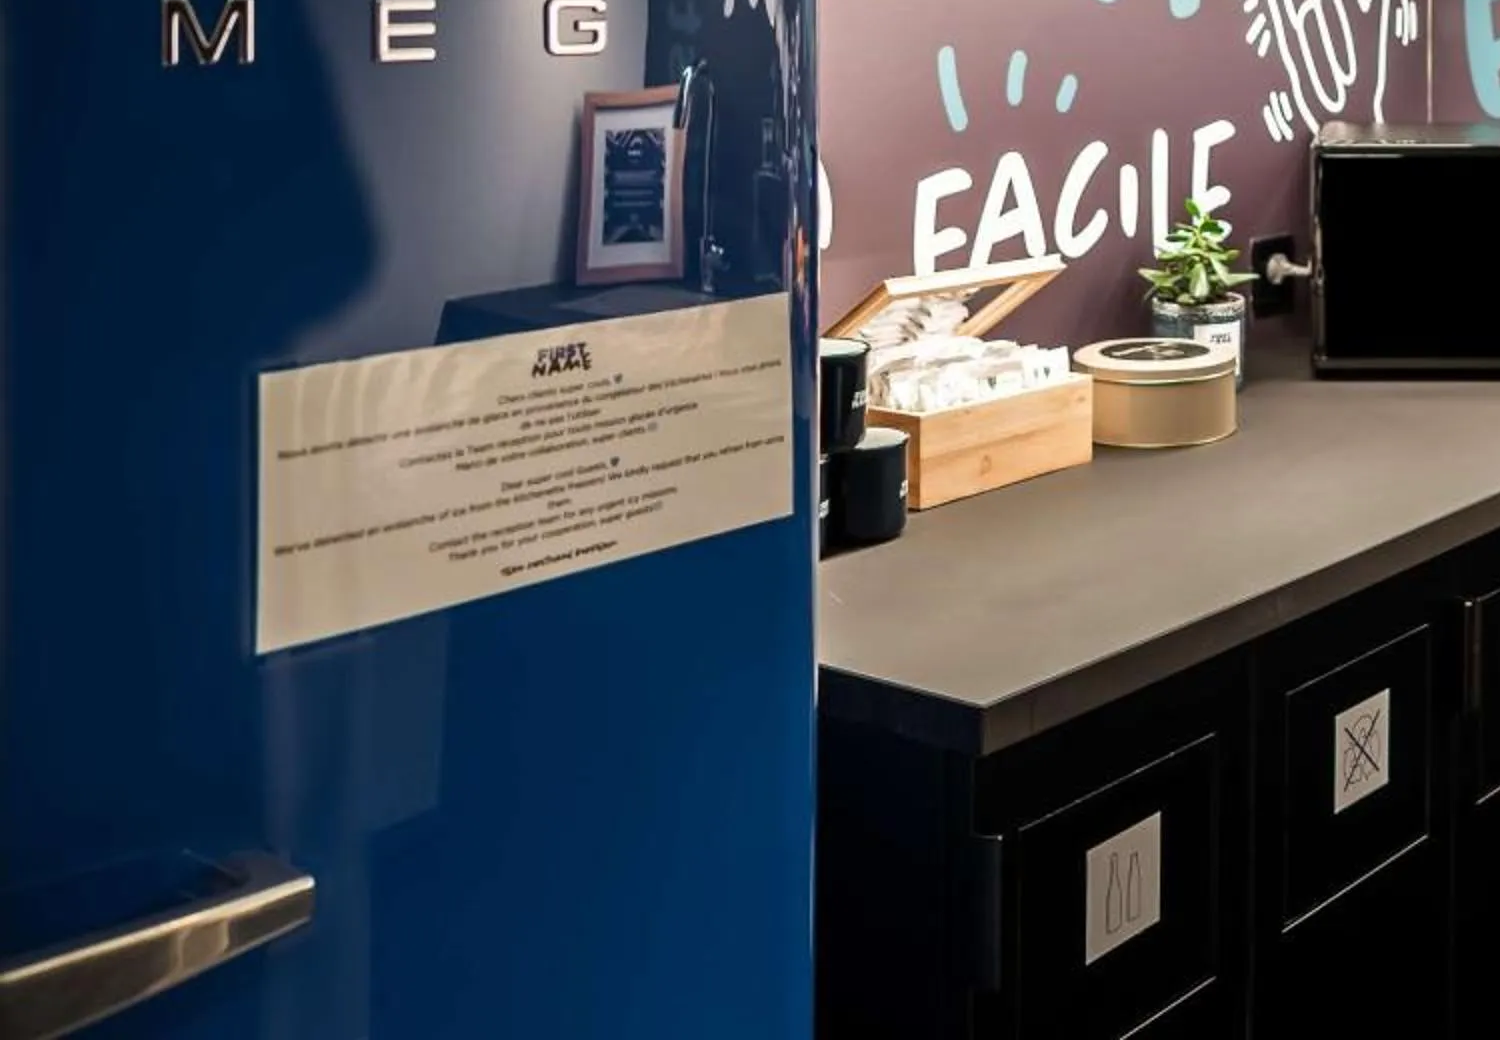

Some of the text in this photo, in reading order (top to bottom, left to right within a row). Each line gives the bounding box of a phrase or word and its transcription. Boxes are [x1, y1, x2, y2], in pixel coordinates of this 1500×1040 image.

[913, 119, 1236, 277] FACILE
[531, 351, 592, 378] NAME
[537, 342, 588, 363] FIRST
